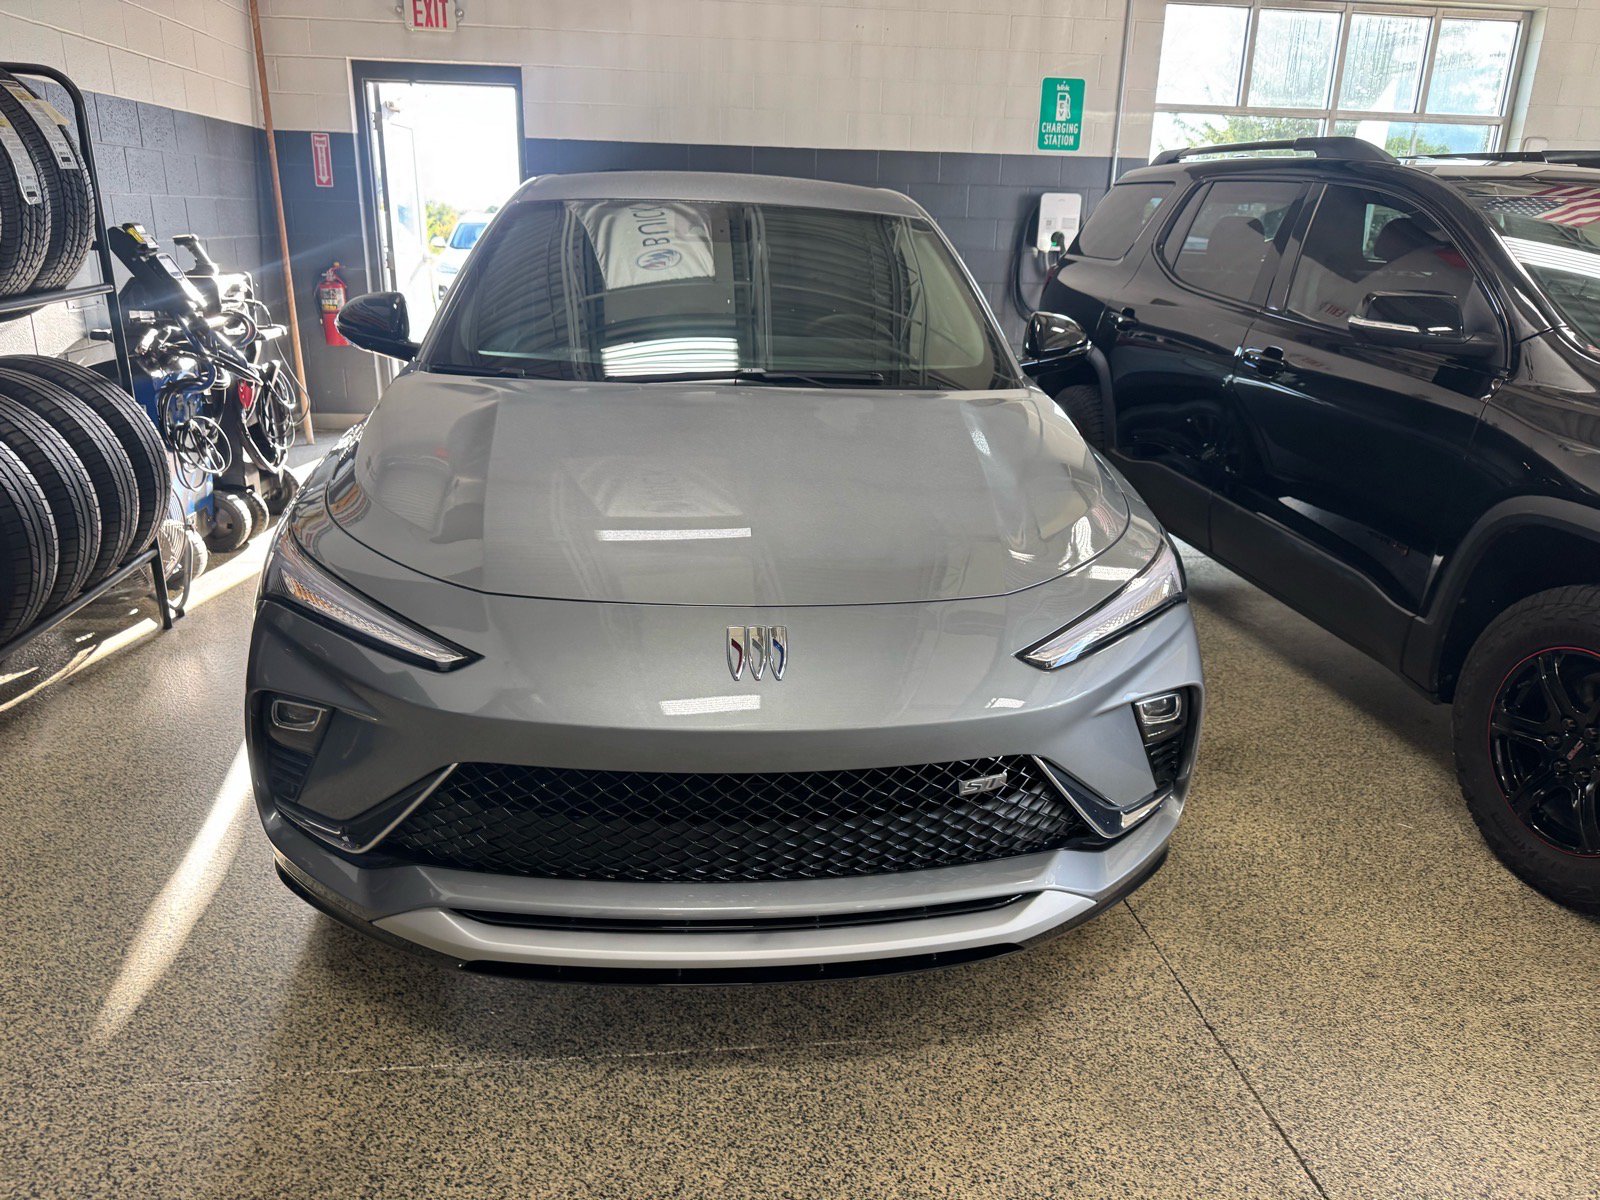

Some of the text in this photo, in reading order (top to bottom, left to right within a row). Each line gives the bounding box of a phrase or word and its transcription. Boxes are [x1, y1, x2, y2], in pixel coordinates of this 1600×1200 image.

[412, 0, 448, 28] EXIT
[1041, 122, 1078, 134] CHARGING
[1043, 134, 1074, 146] STATION
